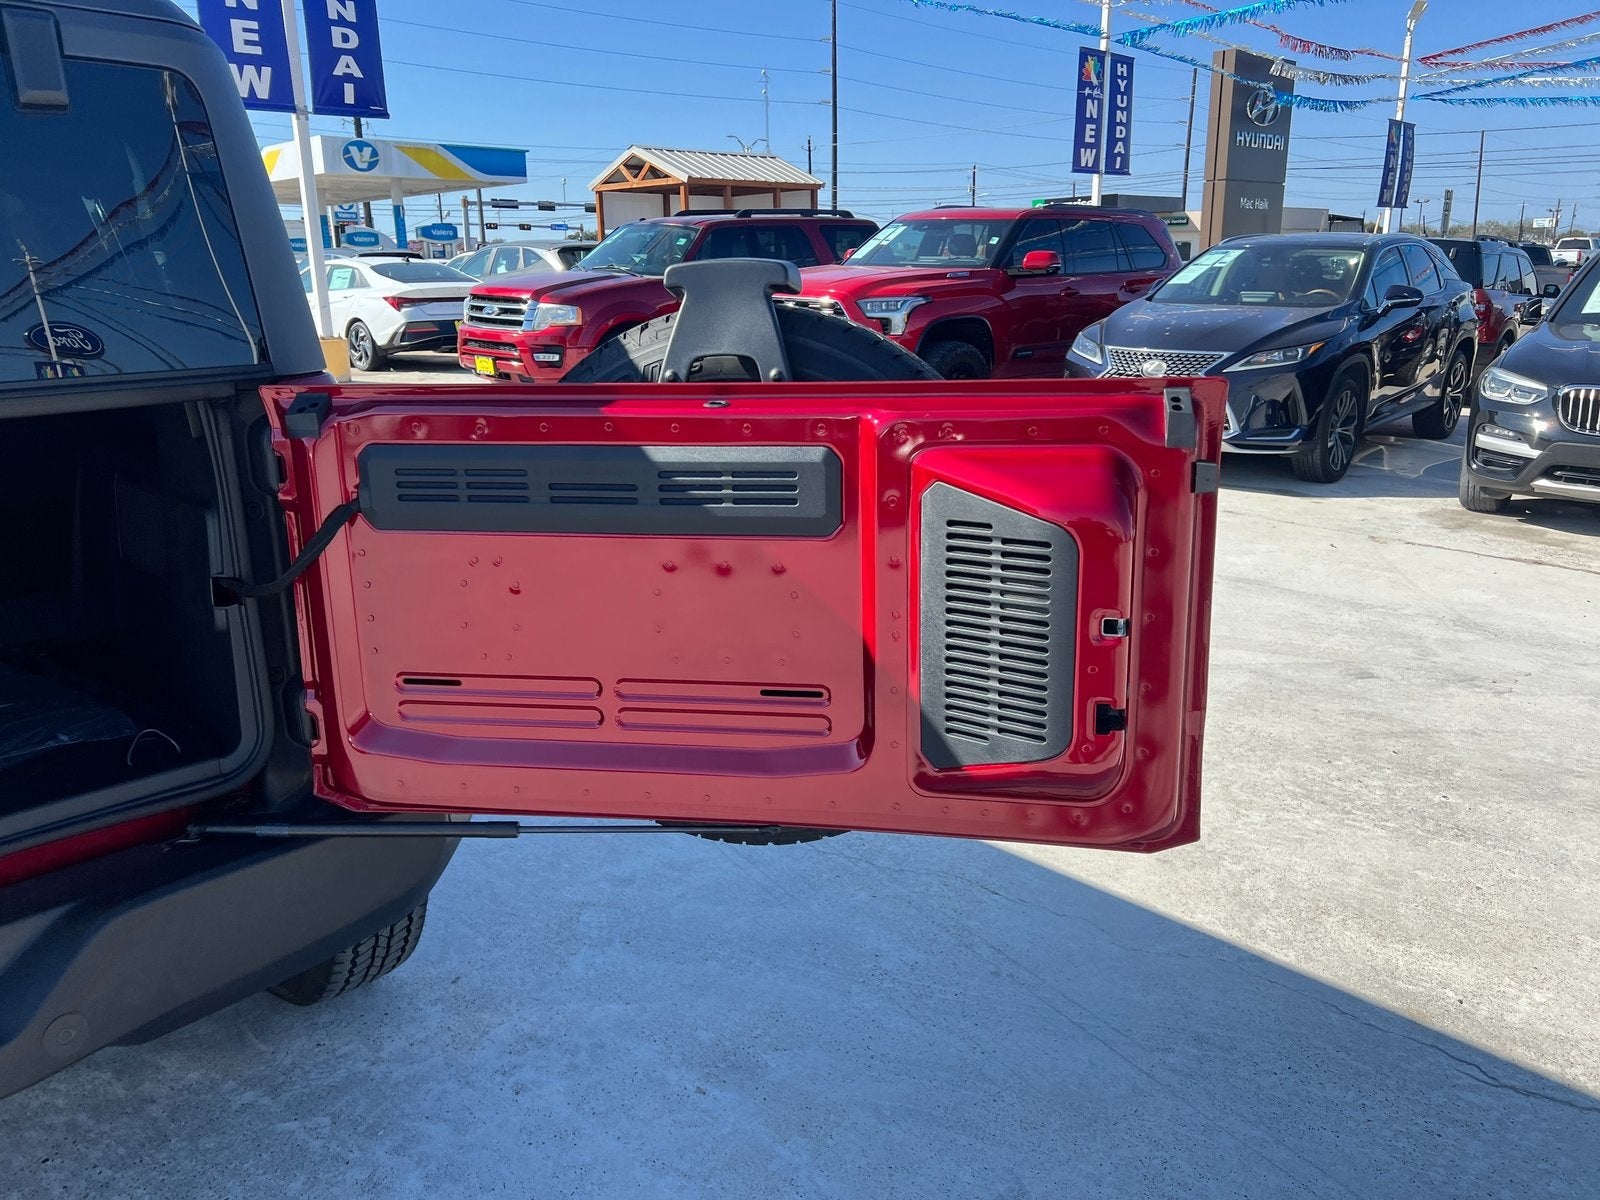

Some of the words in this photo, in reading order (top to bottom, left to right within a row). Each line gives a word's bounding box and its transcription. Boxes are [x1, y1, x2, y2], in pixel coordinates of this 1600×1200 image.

[1080, 99, 1098, 168] NEW
[1113, 63, 1128, 169] HYUNDAI
[1236, 130, 1285, 151] HYUNDAI
[1240, 197, 1254, 209] Mac
[1255, 198, 1269, 210] Haik
